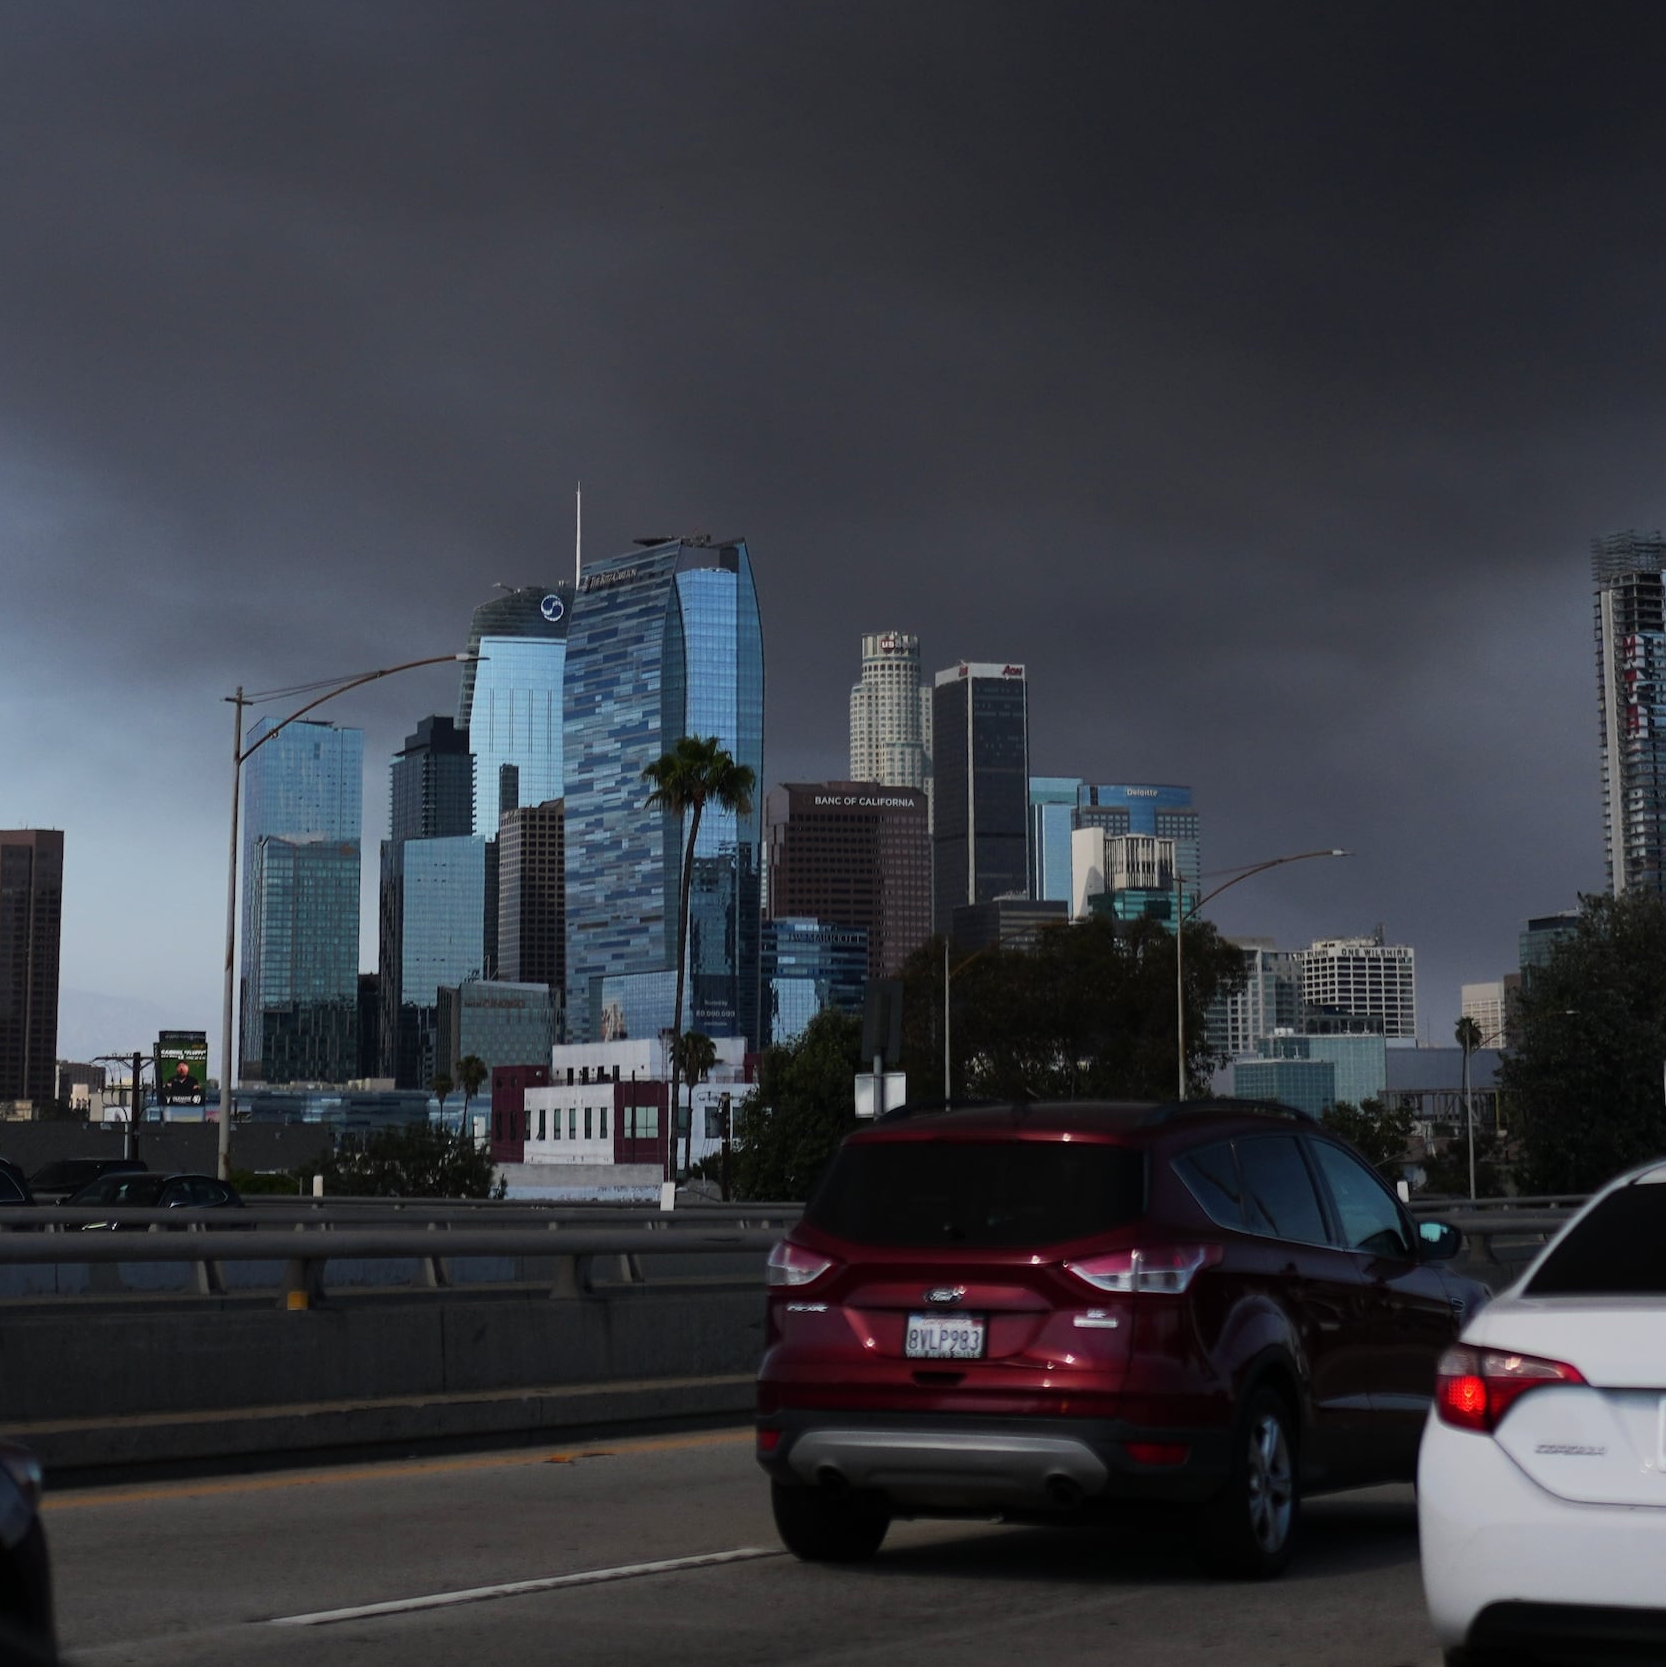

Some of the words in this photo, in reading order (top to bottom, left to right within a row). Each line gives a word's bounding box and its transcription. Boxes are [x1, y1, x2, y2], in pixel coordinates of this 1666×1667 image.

[814, 796, 841, 805] BANC
[844, 797, 857, 805] OF
[859, 797, 914, 807] CALIFORNIA
